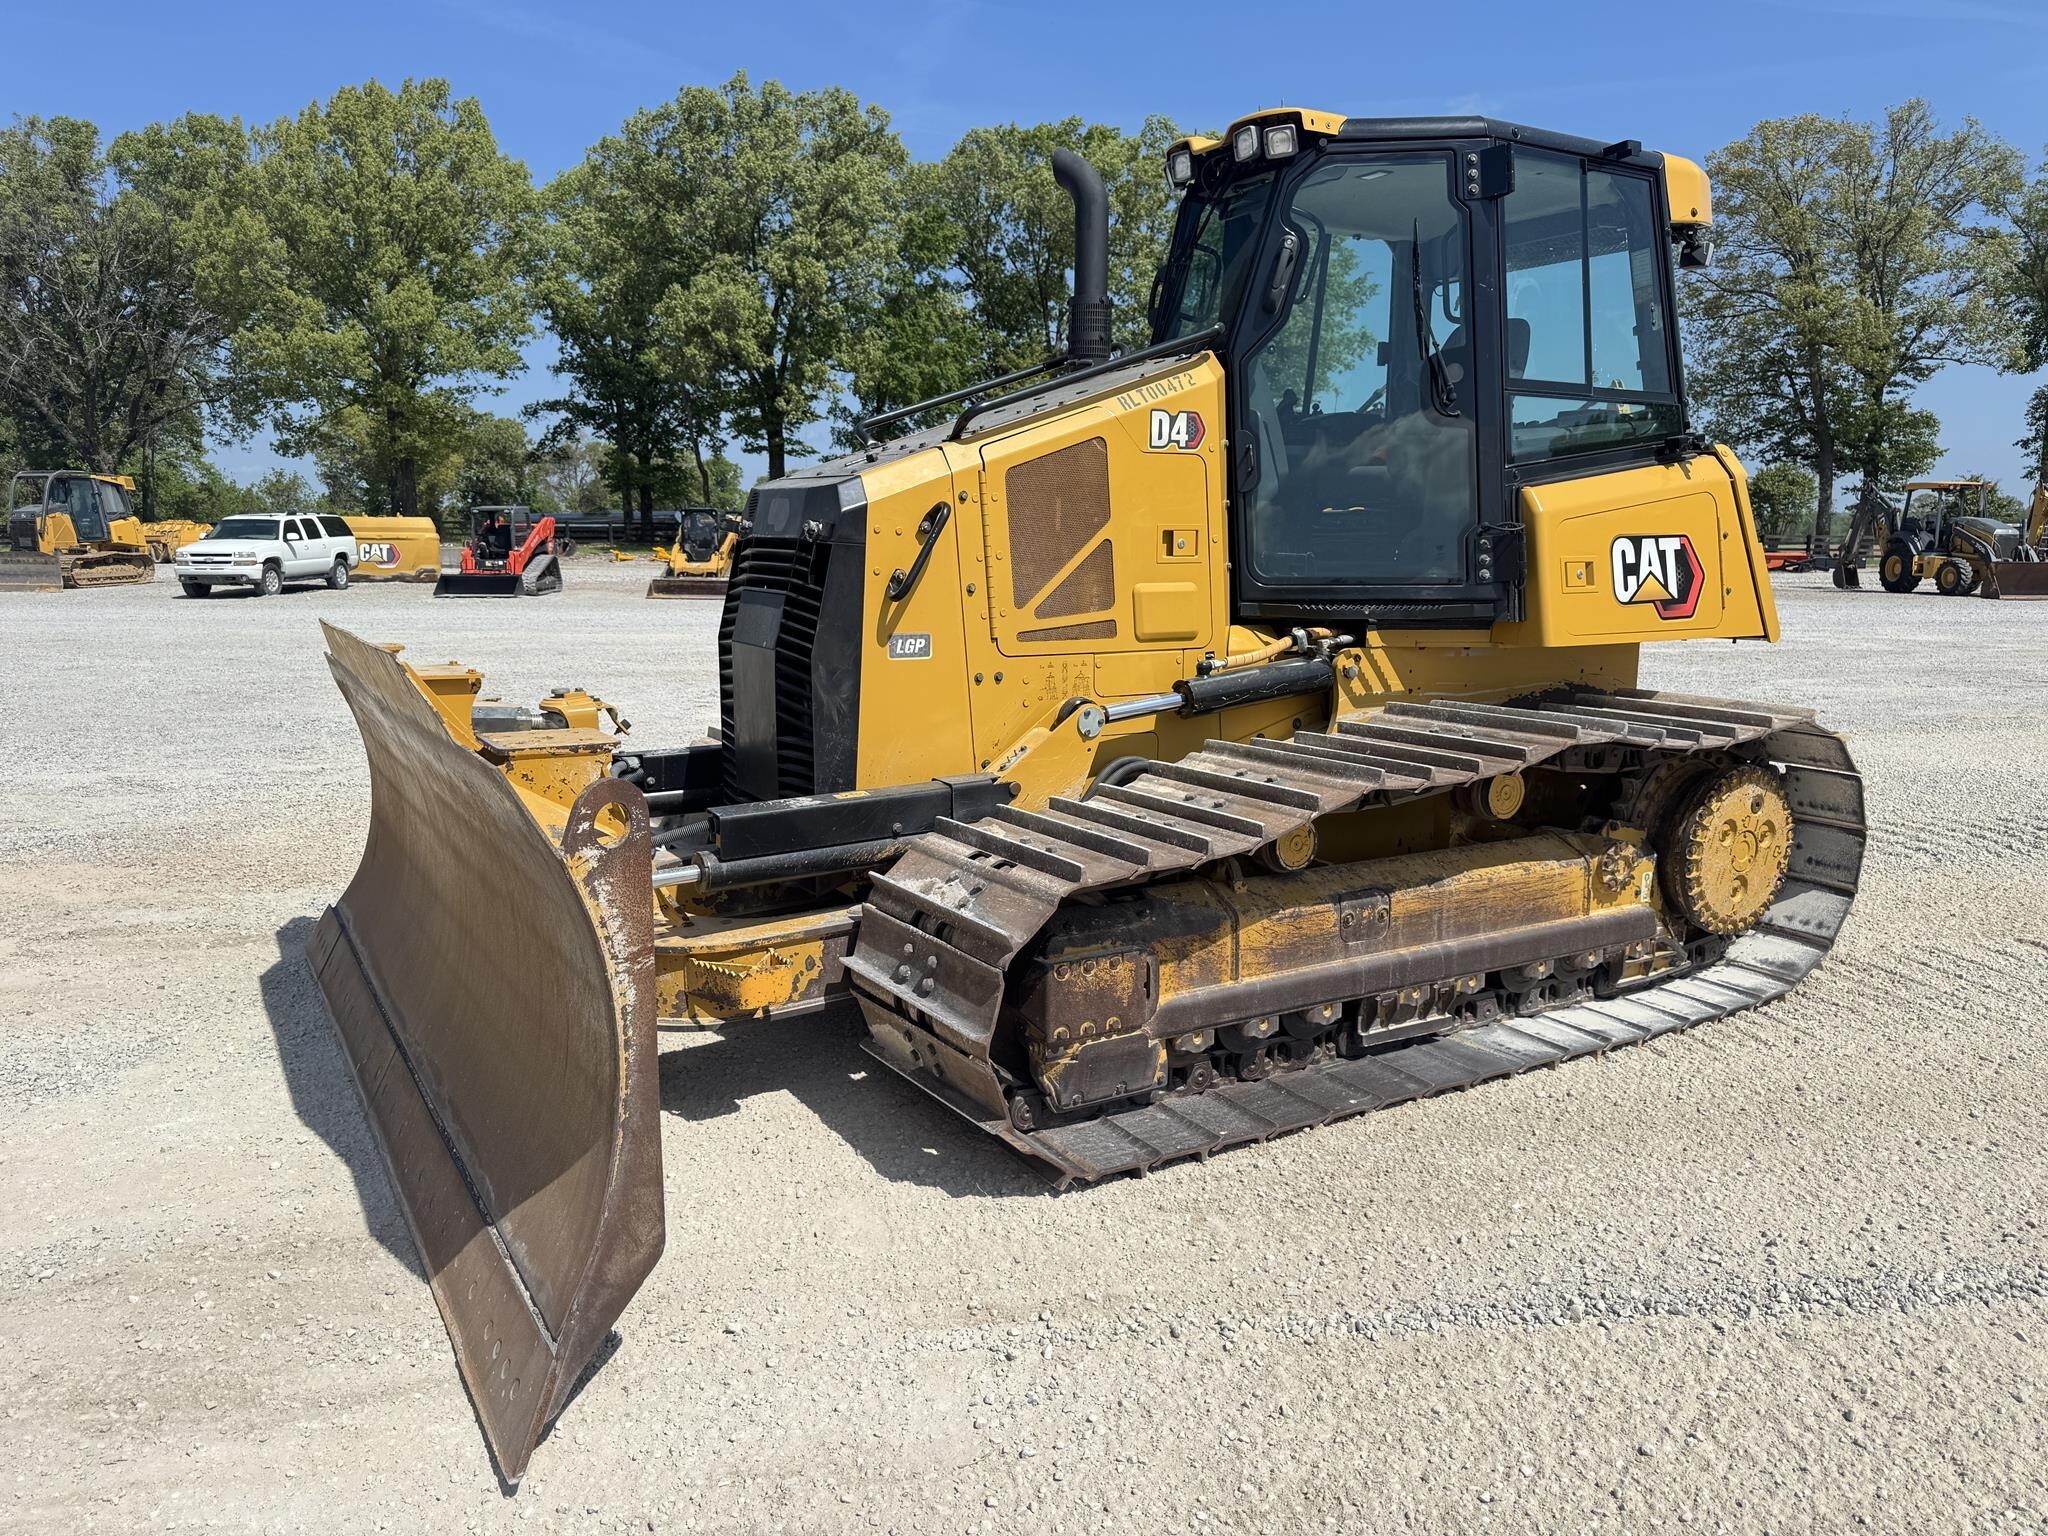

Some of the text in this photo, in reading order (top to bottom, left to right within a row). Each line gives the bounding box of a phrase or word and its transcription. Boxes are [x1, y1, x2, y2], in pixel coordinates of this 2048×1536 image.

[1150, 410, 1189, 448] D4
[359, 543, 391, 562] CAT
[1611, 536, 1682, 603] CAT
[896, 638, 926, 654] LGP
